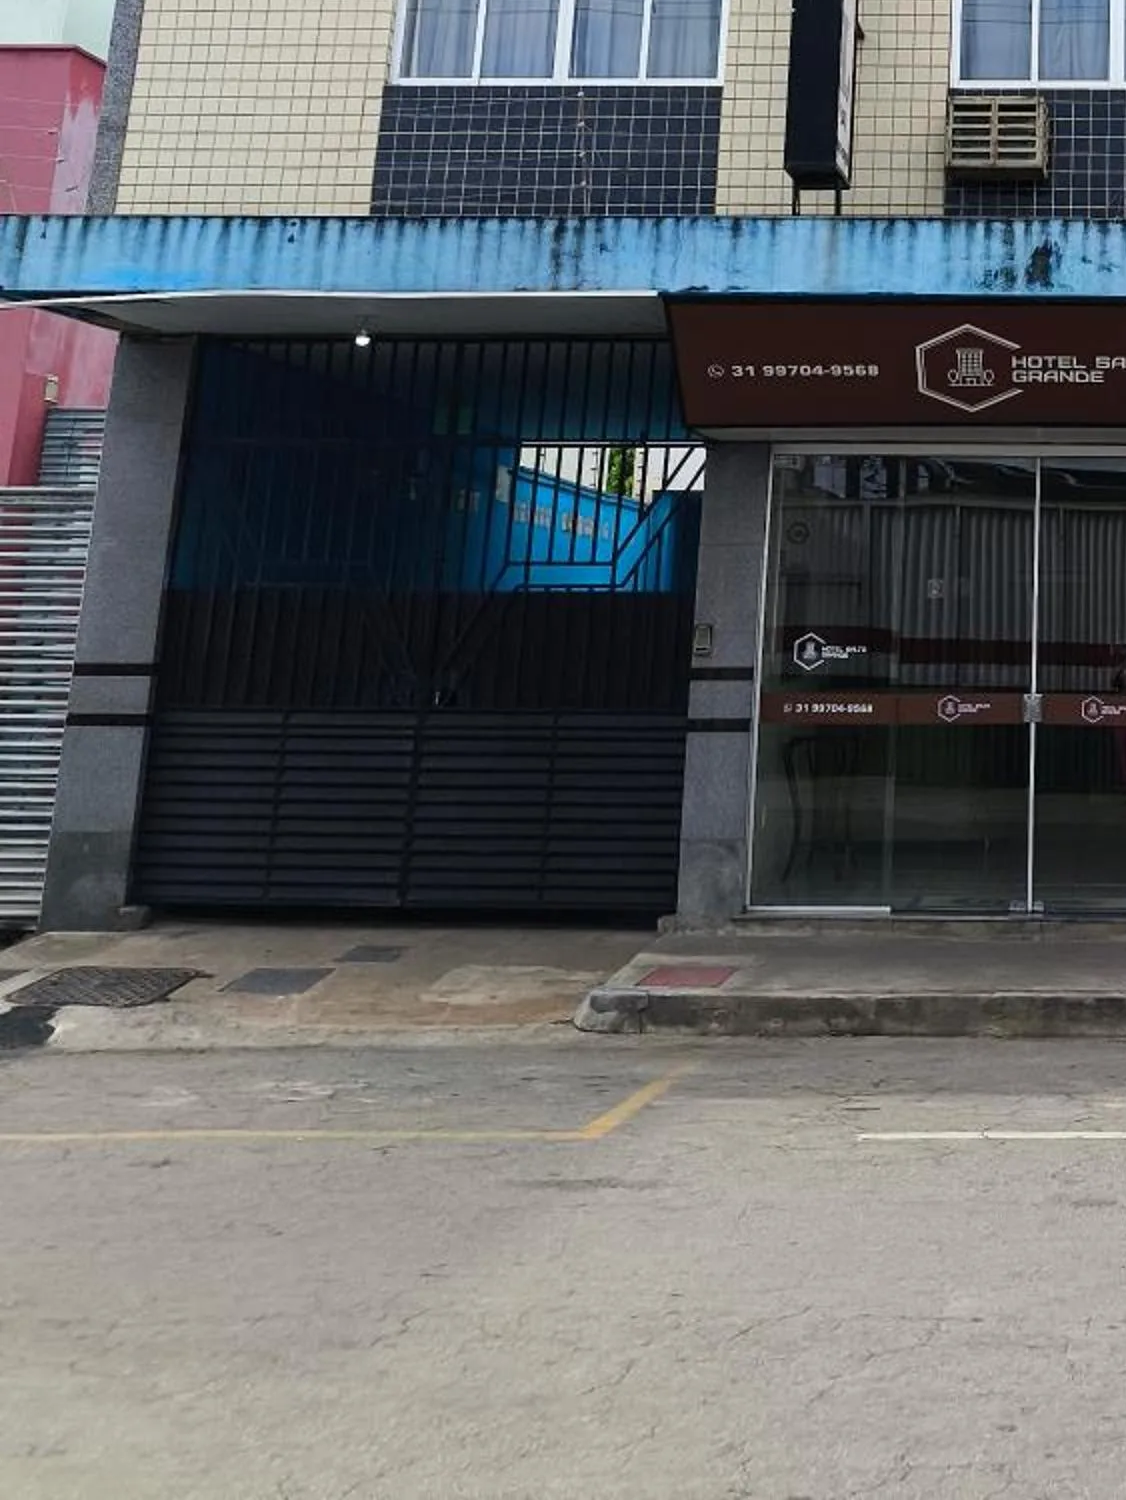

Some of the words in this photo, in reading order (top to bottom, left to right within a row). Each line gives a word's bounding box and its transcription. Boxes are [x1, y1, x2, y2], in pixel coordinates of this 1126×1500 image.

[1011, 355, 1087, 369] HOTEL
[730, 364, 756, 377] 31
[762, 364, 880, 377] 99704-9568
[1012, 369, 1105, 383] GRANDE
